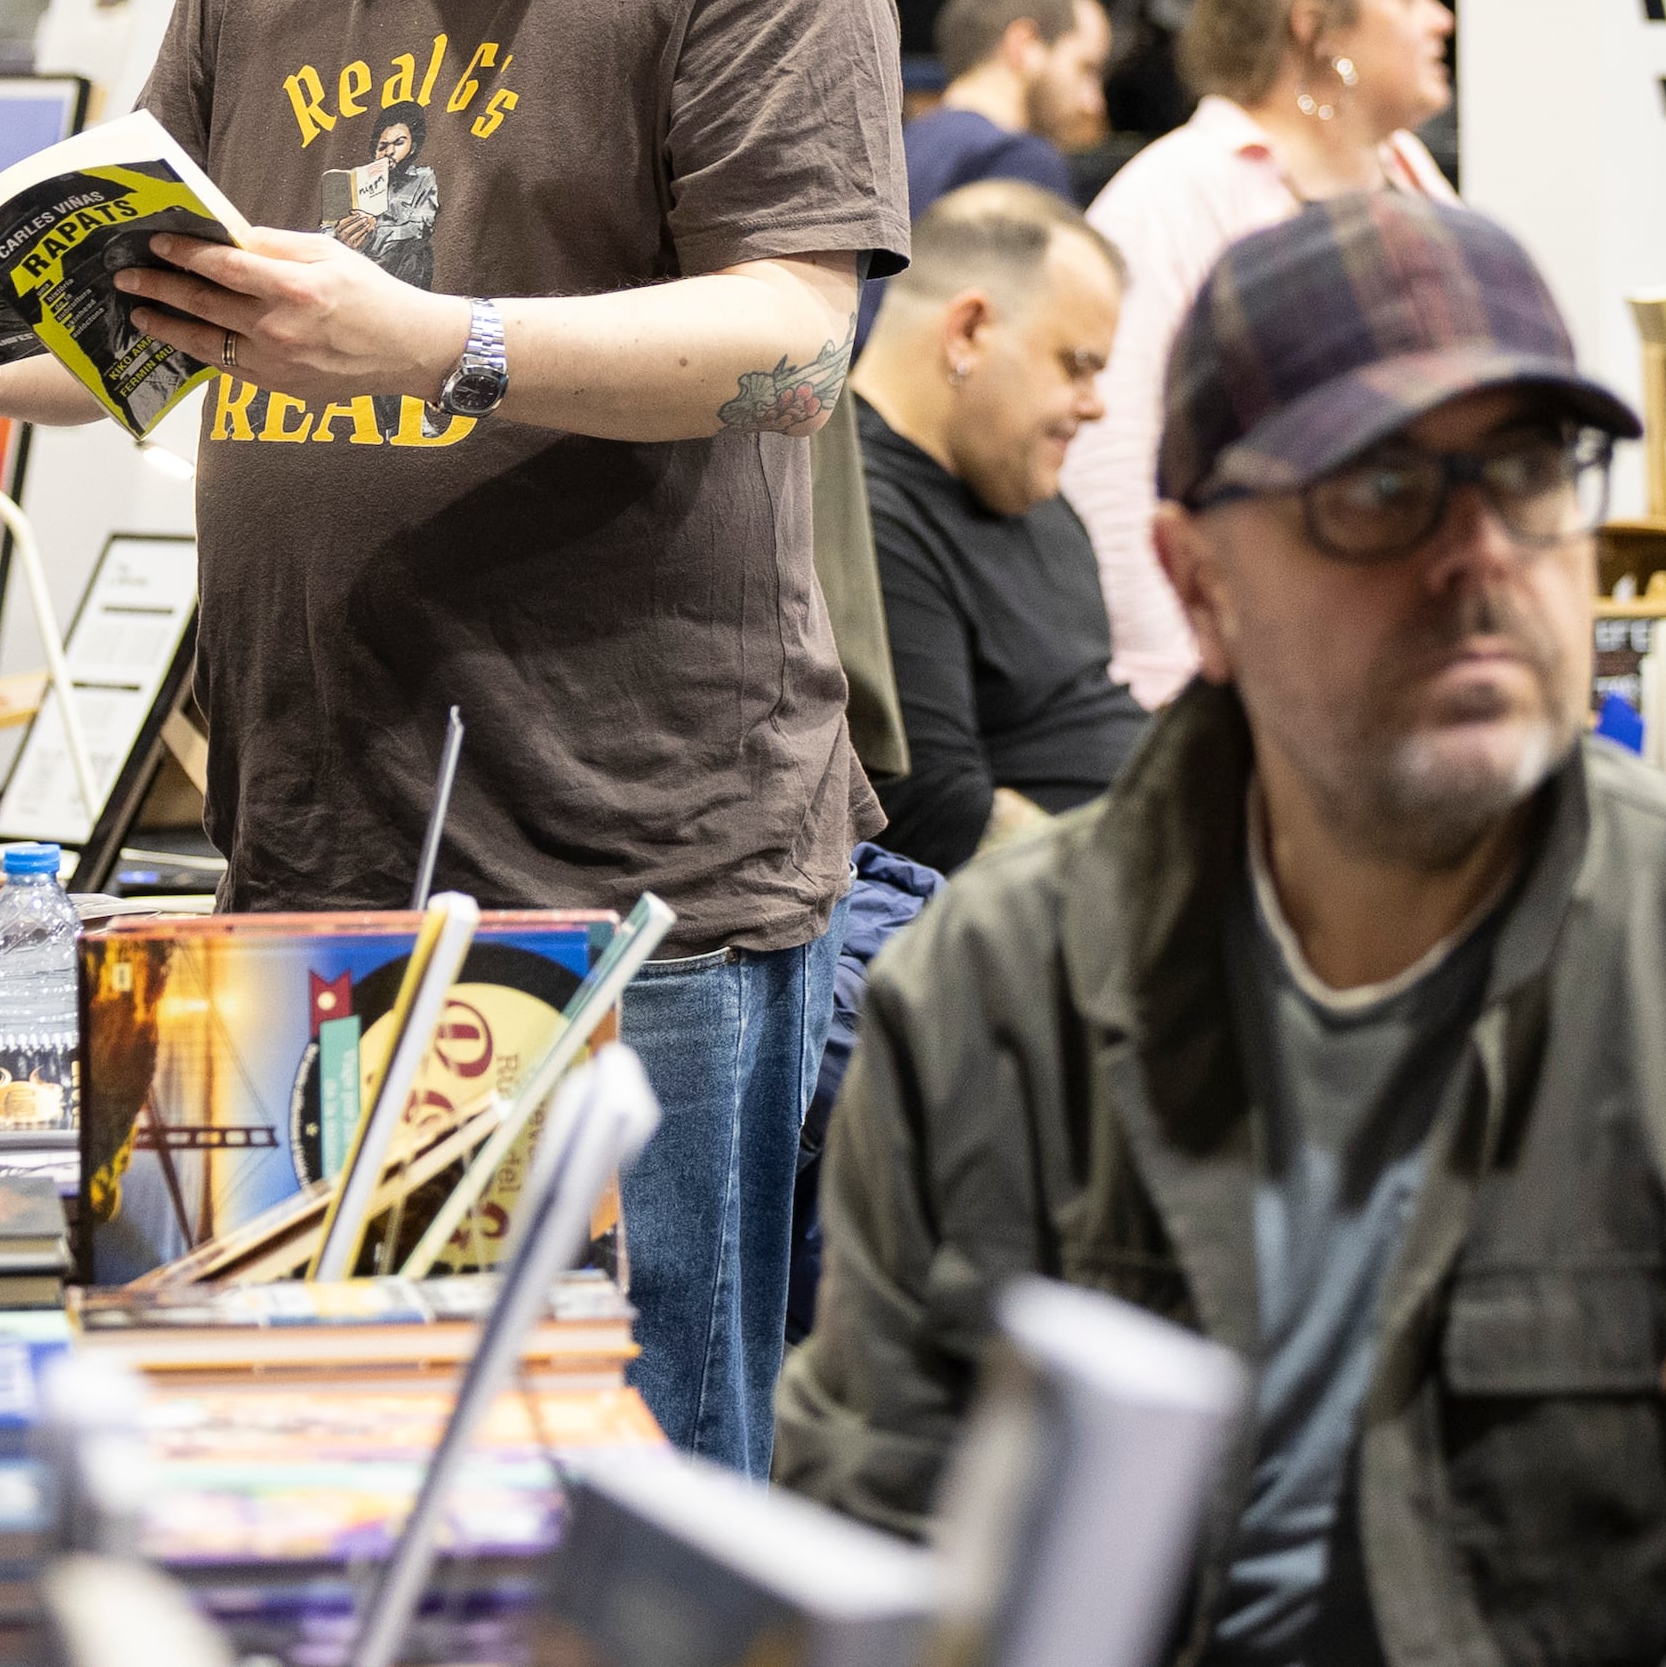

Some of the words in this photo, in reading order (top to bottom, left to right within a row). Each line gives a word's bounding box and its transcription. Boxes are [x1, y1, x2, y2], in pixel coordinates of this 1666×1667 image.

[283, 33, 448, 149] Real
[446, 42, 520, 140] G's
[53, 190, 105, 215] VIÑAS
[21, 199, 139, 279] RAPATS
[56, 287, 93, 322] subcultura
[66, 299, 97, 329] skinhead
[108, 356, 132, 382] KIKO
[132, 336, 155, 360] AMA
[119, 360, 156, 398] FERMIN
[210, 373, 478, 447] READ
